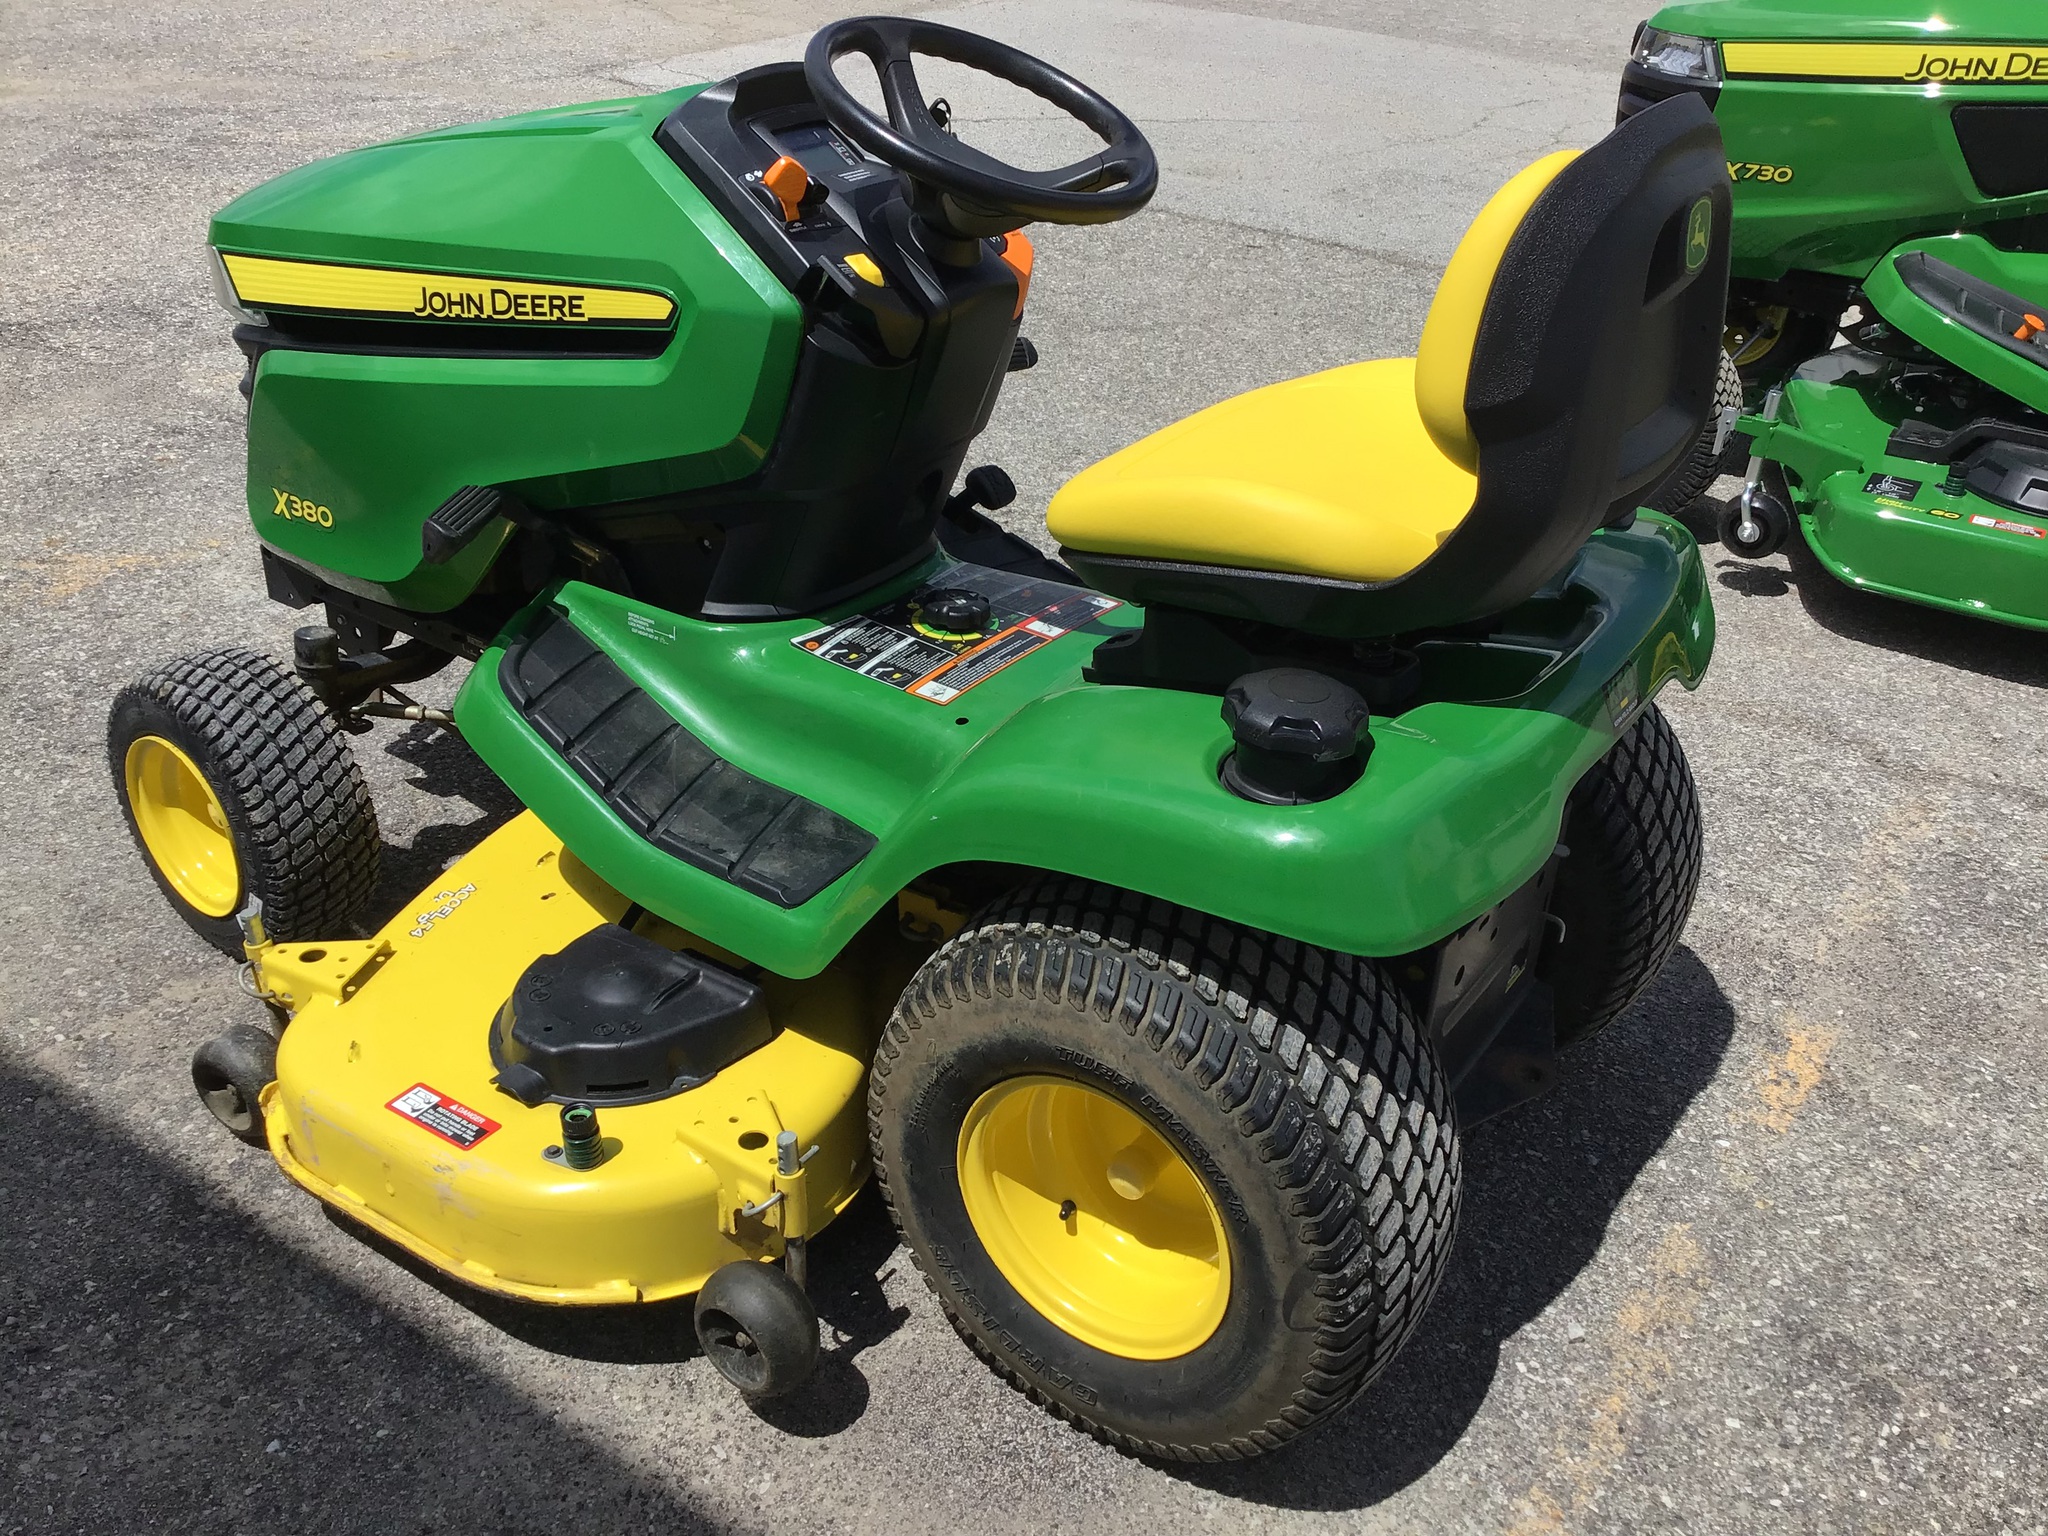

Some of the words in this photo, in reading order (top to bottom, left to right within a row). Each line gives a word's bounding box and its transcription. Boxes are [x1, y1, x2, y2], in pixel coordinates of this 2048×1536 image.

[1904, 53, 1999, 78] JOHN
[2003, 52, 2048, 78] DE
[1725, 161, 1793, 183] X730
[414, 286, 485, 316] JOHN
[490, 288, 586, 319] DEERE
[271, 487, 334, 528] X380
[1930, 509, 1960, 519] 60
[429, 883, 477, 919] ACCEL
[456, 1105, 486, 1124] DANGER
[1055, 1046, 1135, 1091] TURF
[1141, 1094, 1250, 1224] MASTER
[928, 1243, 1099, 1408] CARLISLE
